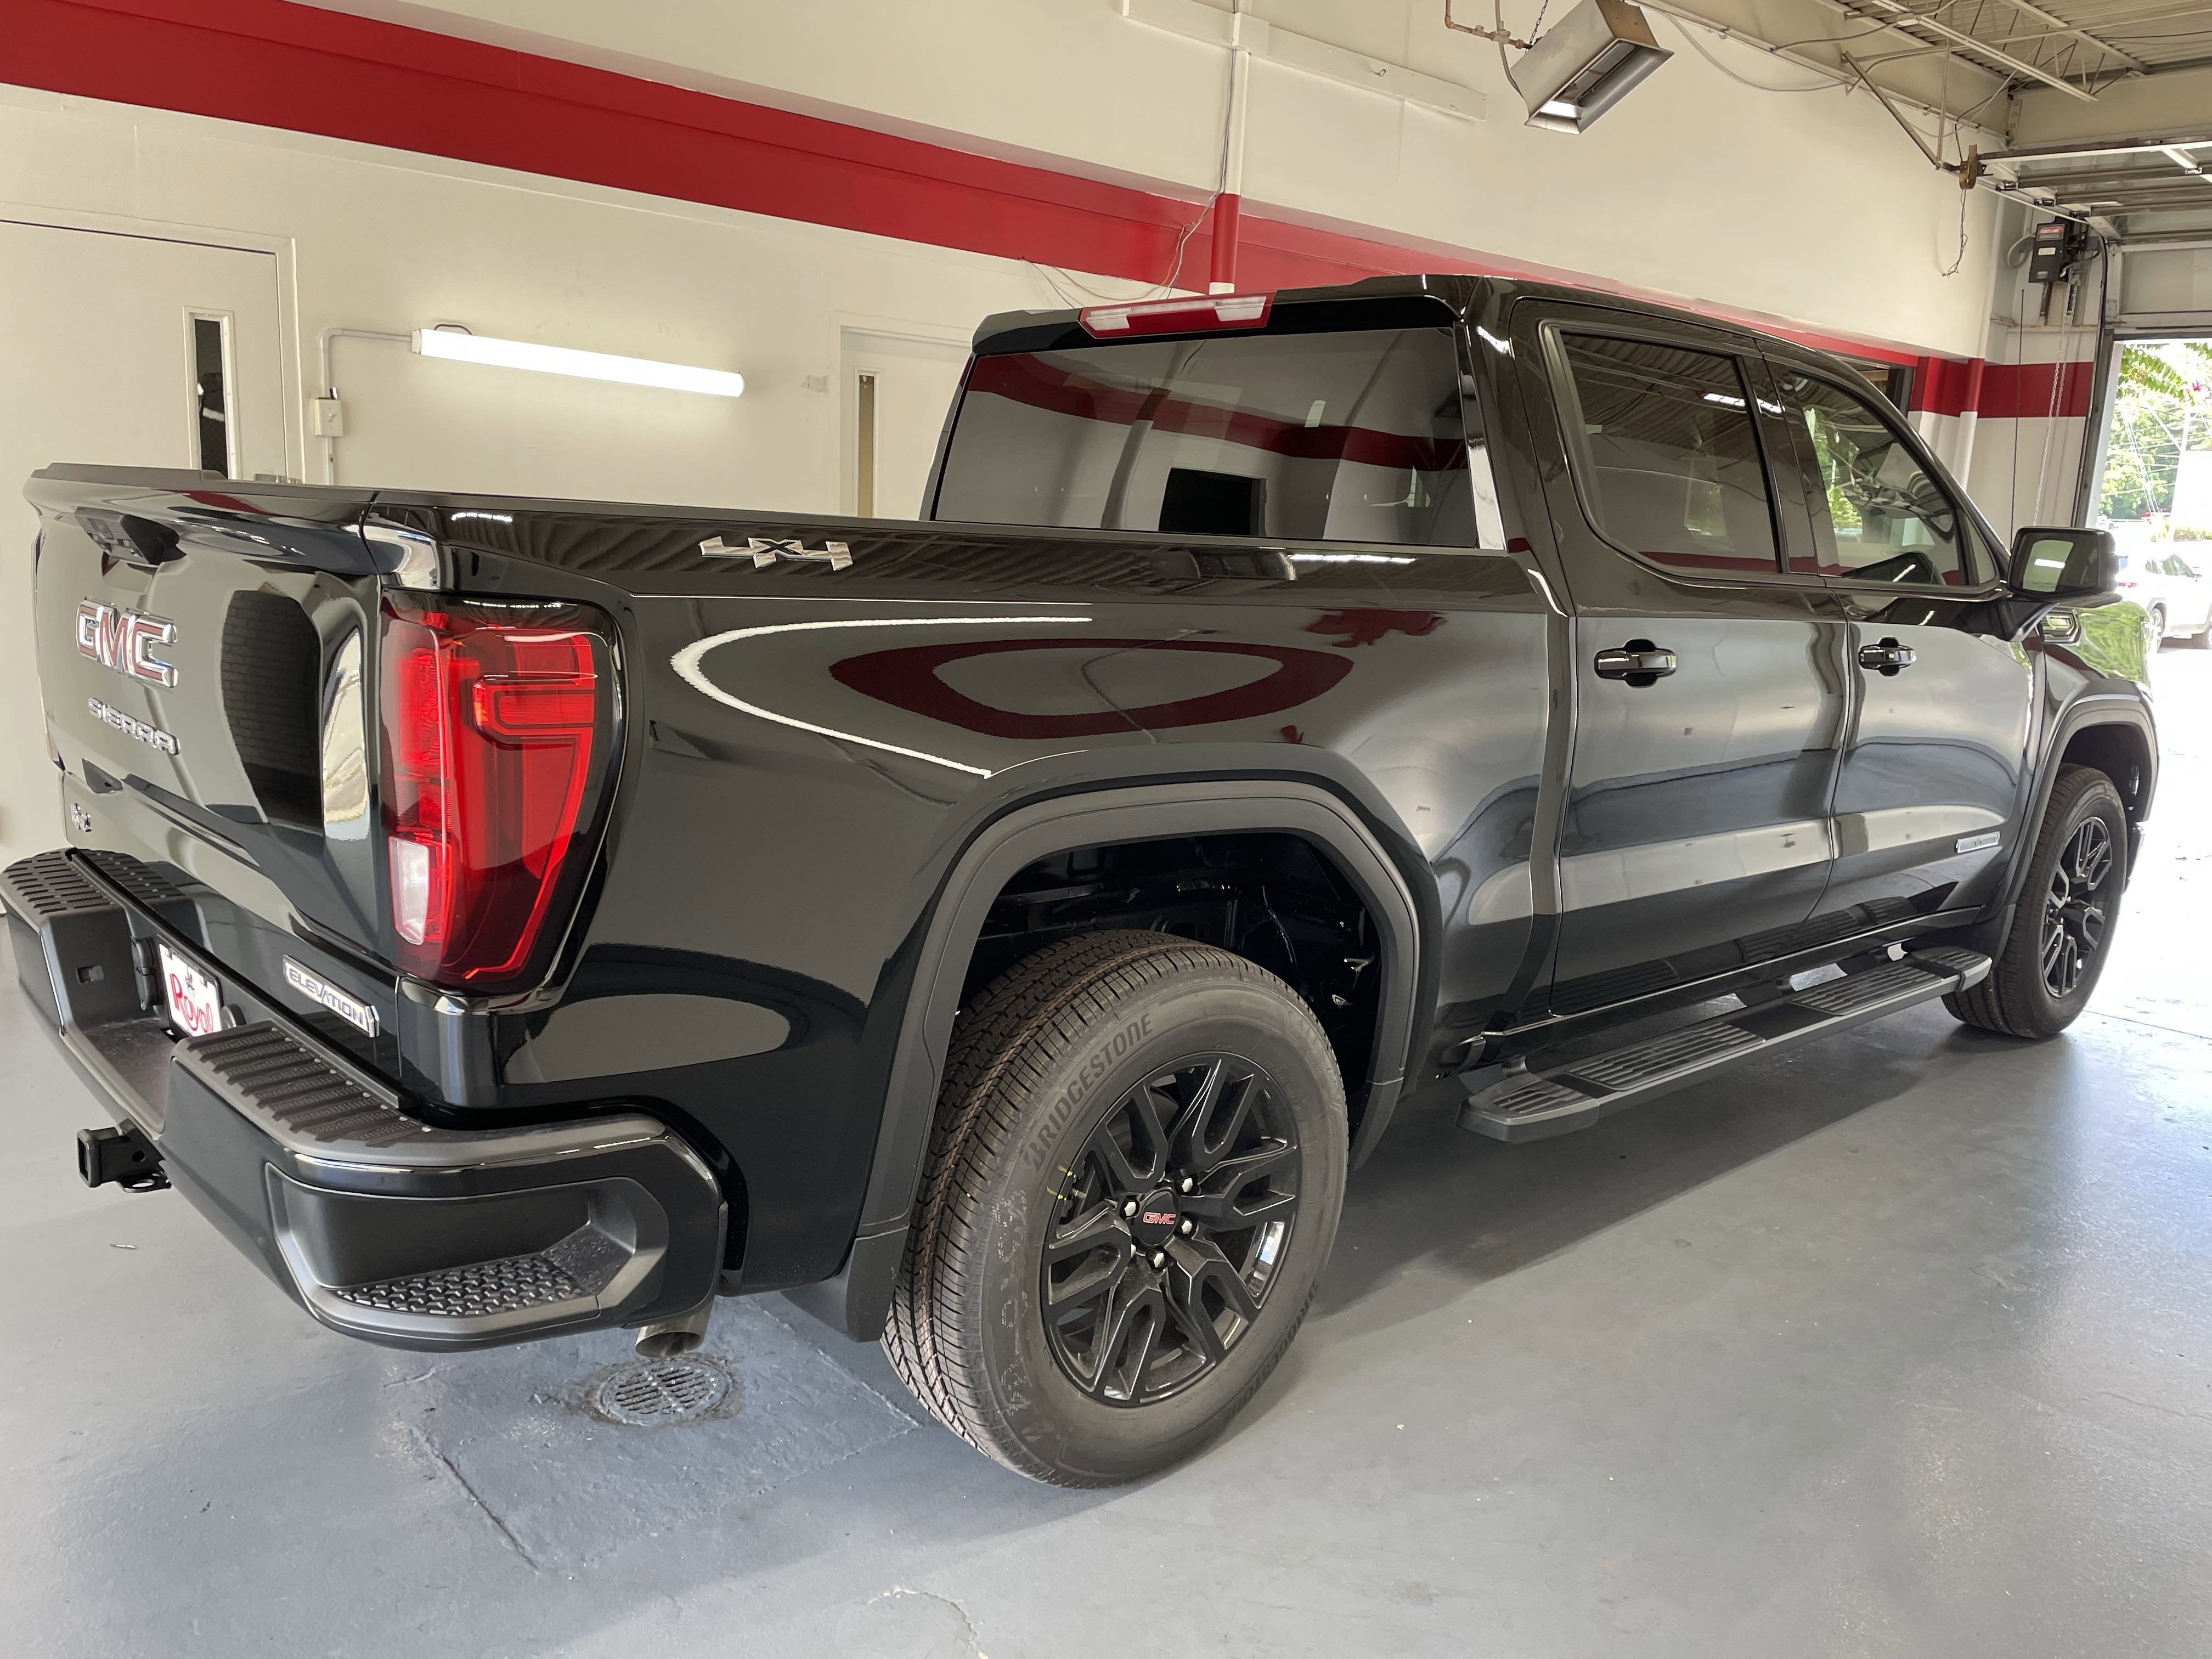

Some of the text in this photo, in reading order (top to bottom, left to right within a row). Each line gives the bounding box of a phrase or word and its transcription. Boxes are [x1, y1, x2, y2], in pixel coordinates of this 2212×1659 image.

[76, 597, 179, 689] GMC
[88, 697, 180, 755] SIERRA
[169, 973, 214, 1034] Royal
[289, 968, 364, 1025] ELEVATION
[1023, 1013, 1154, 1173] BRIDGESTONE
[1143, 1211, 1177, 1225] GMC
